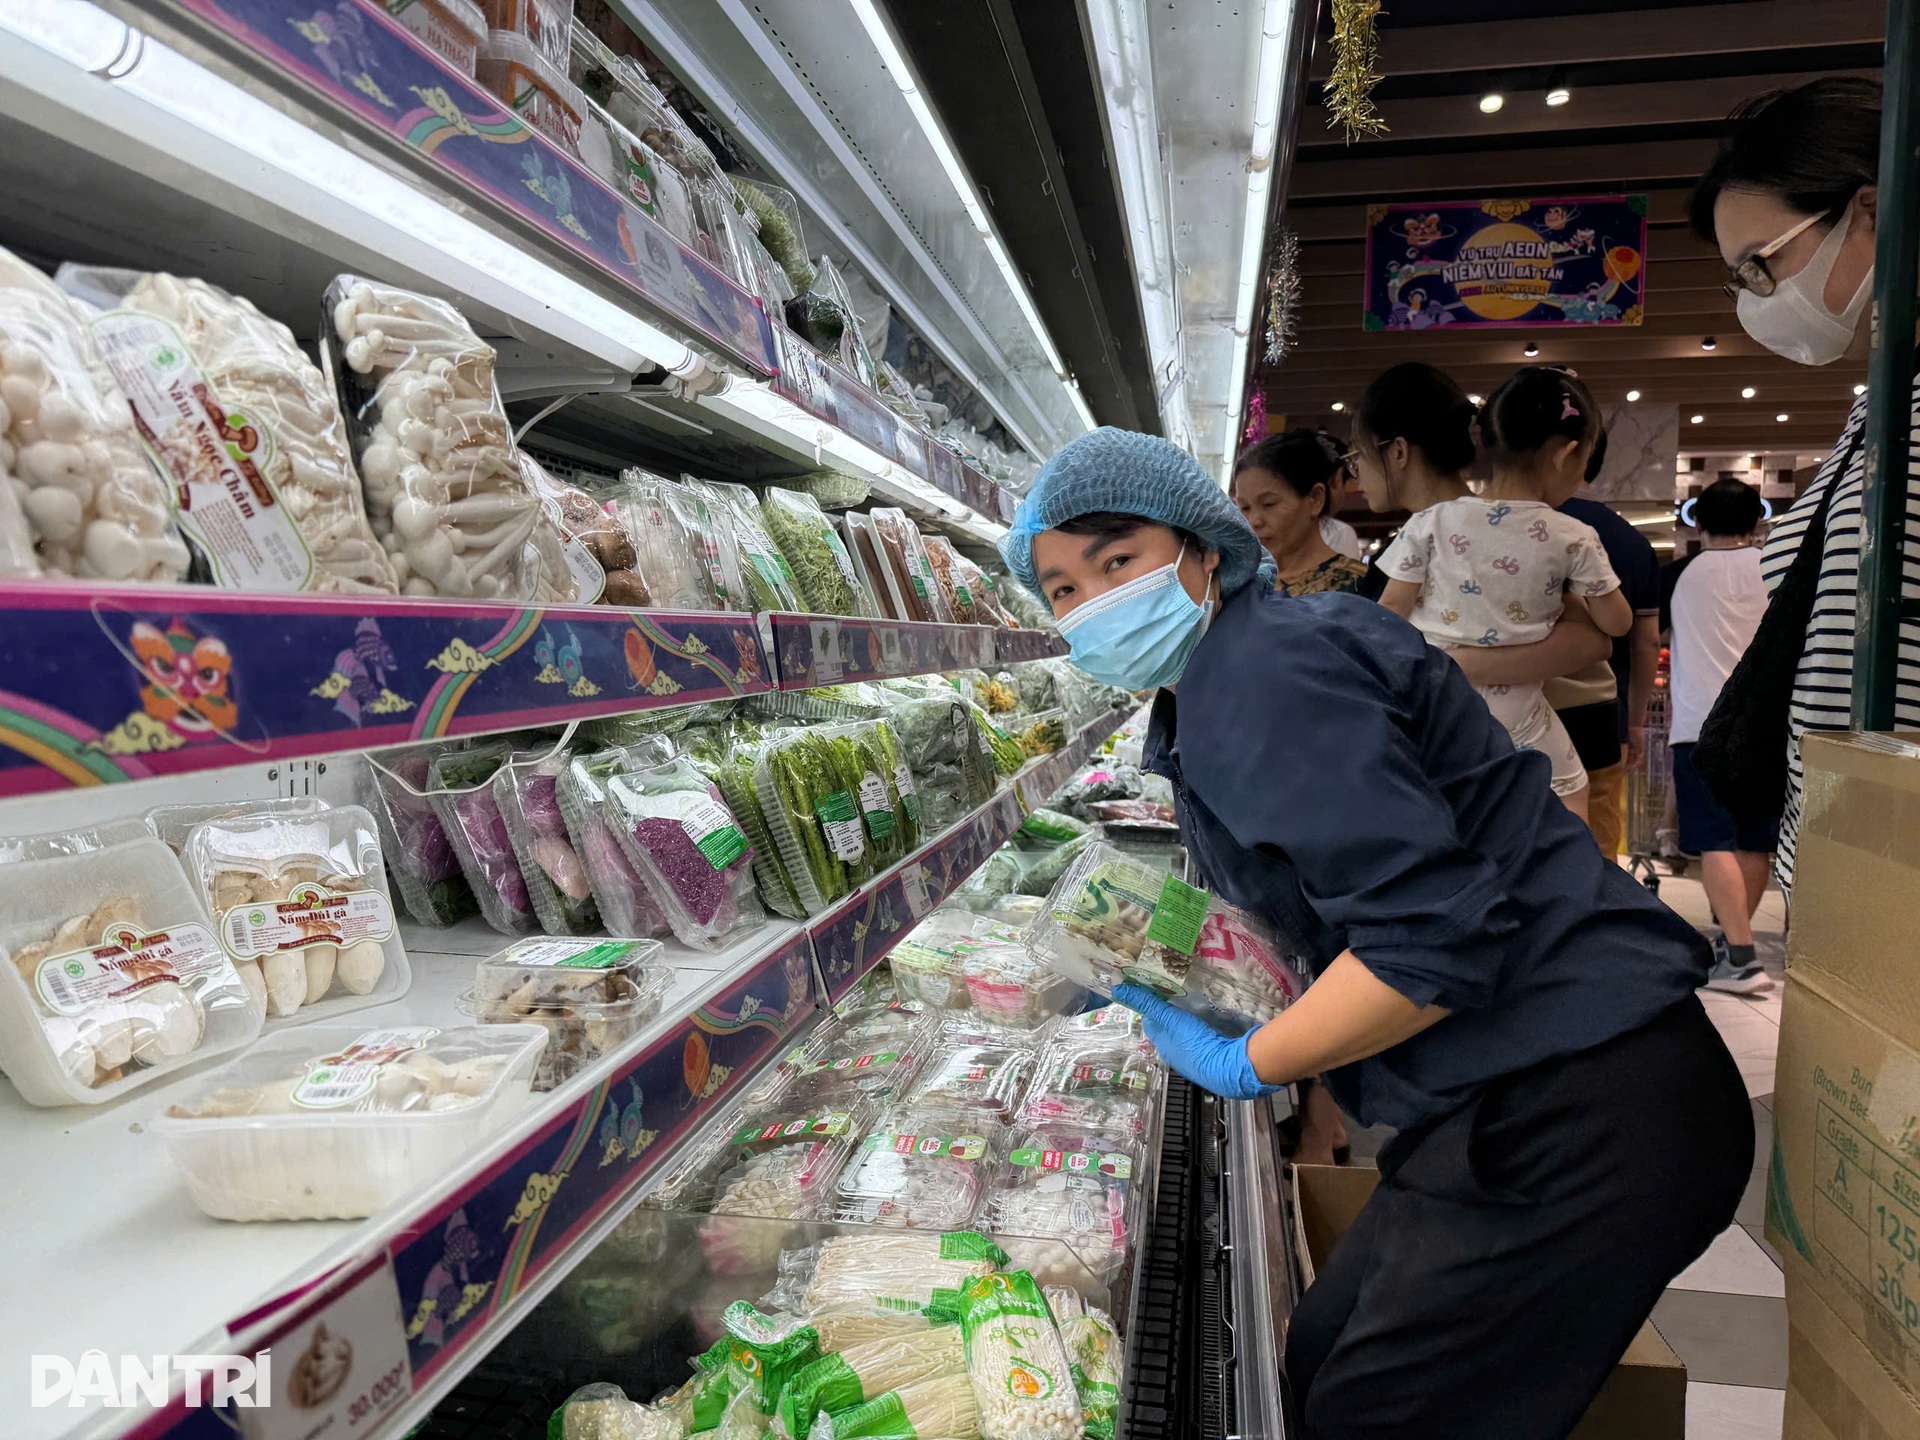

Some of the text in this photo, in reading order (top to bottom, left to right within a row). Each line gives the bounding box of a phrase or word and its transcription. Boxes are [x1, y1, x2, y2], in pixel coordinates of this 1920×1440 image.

[1503, 242, 1549, 258] AEON
[1486, 262, 1513, 279] VUI
[219, 467, 256, 520] Châm
[278, 910, 309, 926] Nấm
[333, 906, 347, 920] gà
[1813, 1065, 1847, 1106] (Brown
[1828, 1119, 1859, 1159] Grade
[1893, 1171, 1920, 1209] Size
[1834, 1156, 1847, 1193] A
